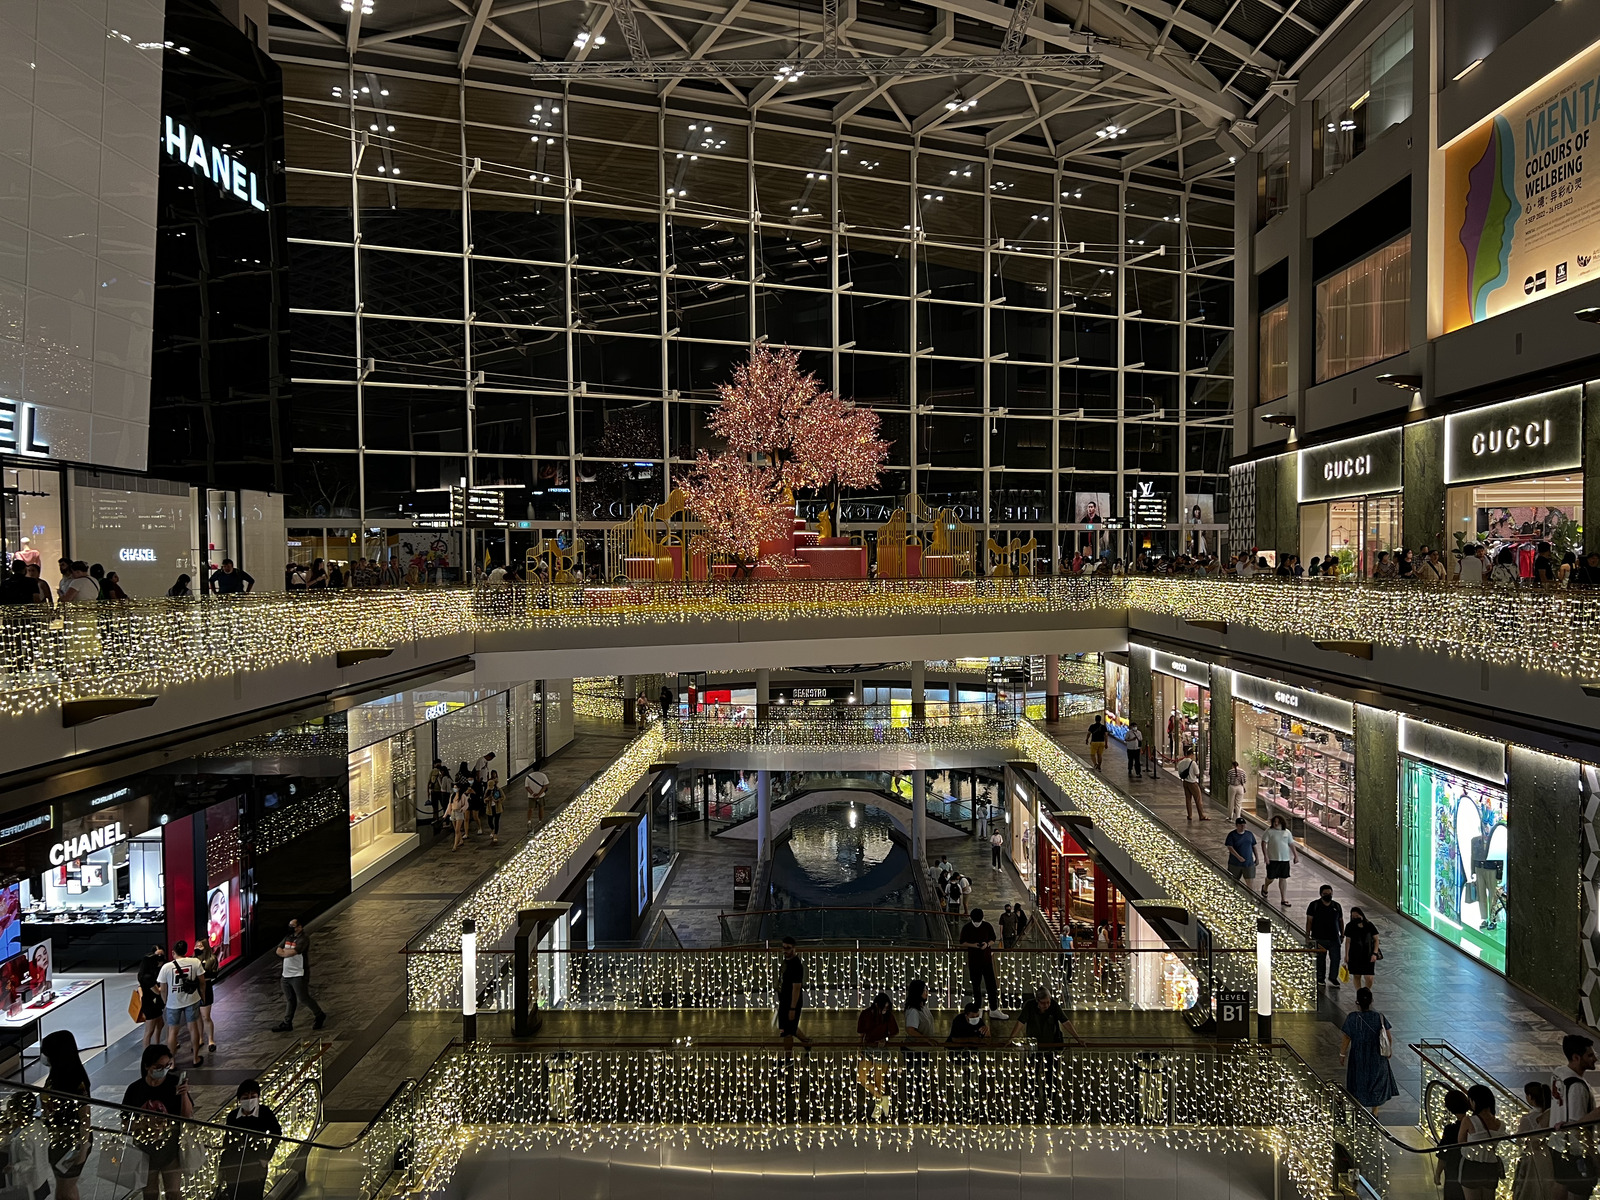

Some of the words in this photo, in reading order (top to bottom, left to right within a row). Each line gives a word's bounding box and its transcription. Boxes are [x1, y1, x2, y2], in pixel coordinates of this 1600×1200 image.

[162, 114, 267, 212] HANEL
[1525, 138, 1572, 179] COLOURS
[1574, 128, 1590, 152] OF
[1525, 155, 1583, 200] WELLBEING
[1554, 201, 1563, 212] FEB
[1471, 418, 1551, 456] GUCCI
[1324, 454, 1371, 481] GUCCI
[119, 547, 157, 562] CHANEL
[1172, 661, 1186, 672] GUCCI
[1275, 691, 1299, 707] GUCCI
[49, 821, 127, 866] CHANEL
[1223, 1005, 1243, 1022] B1
